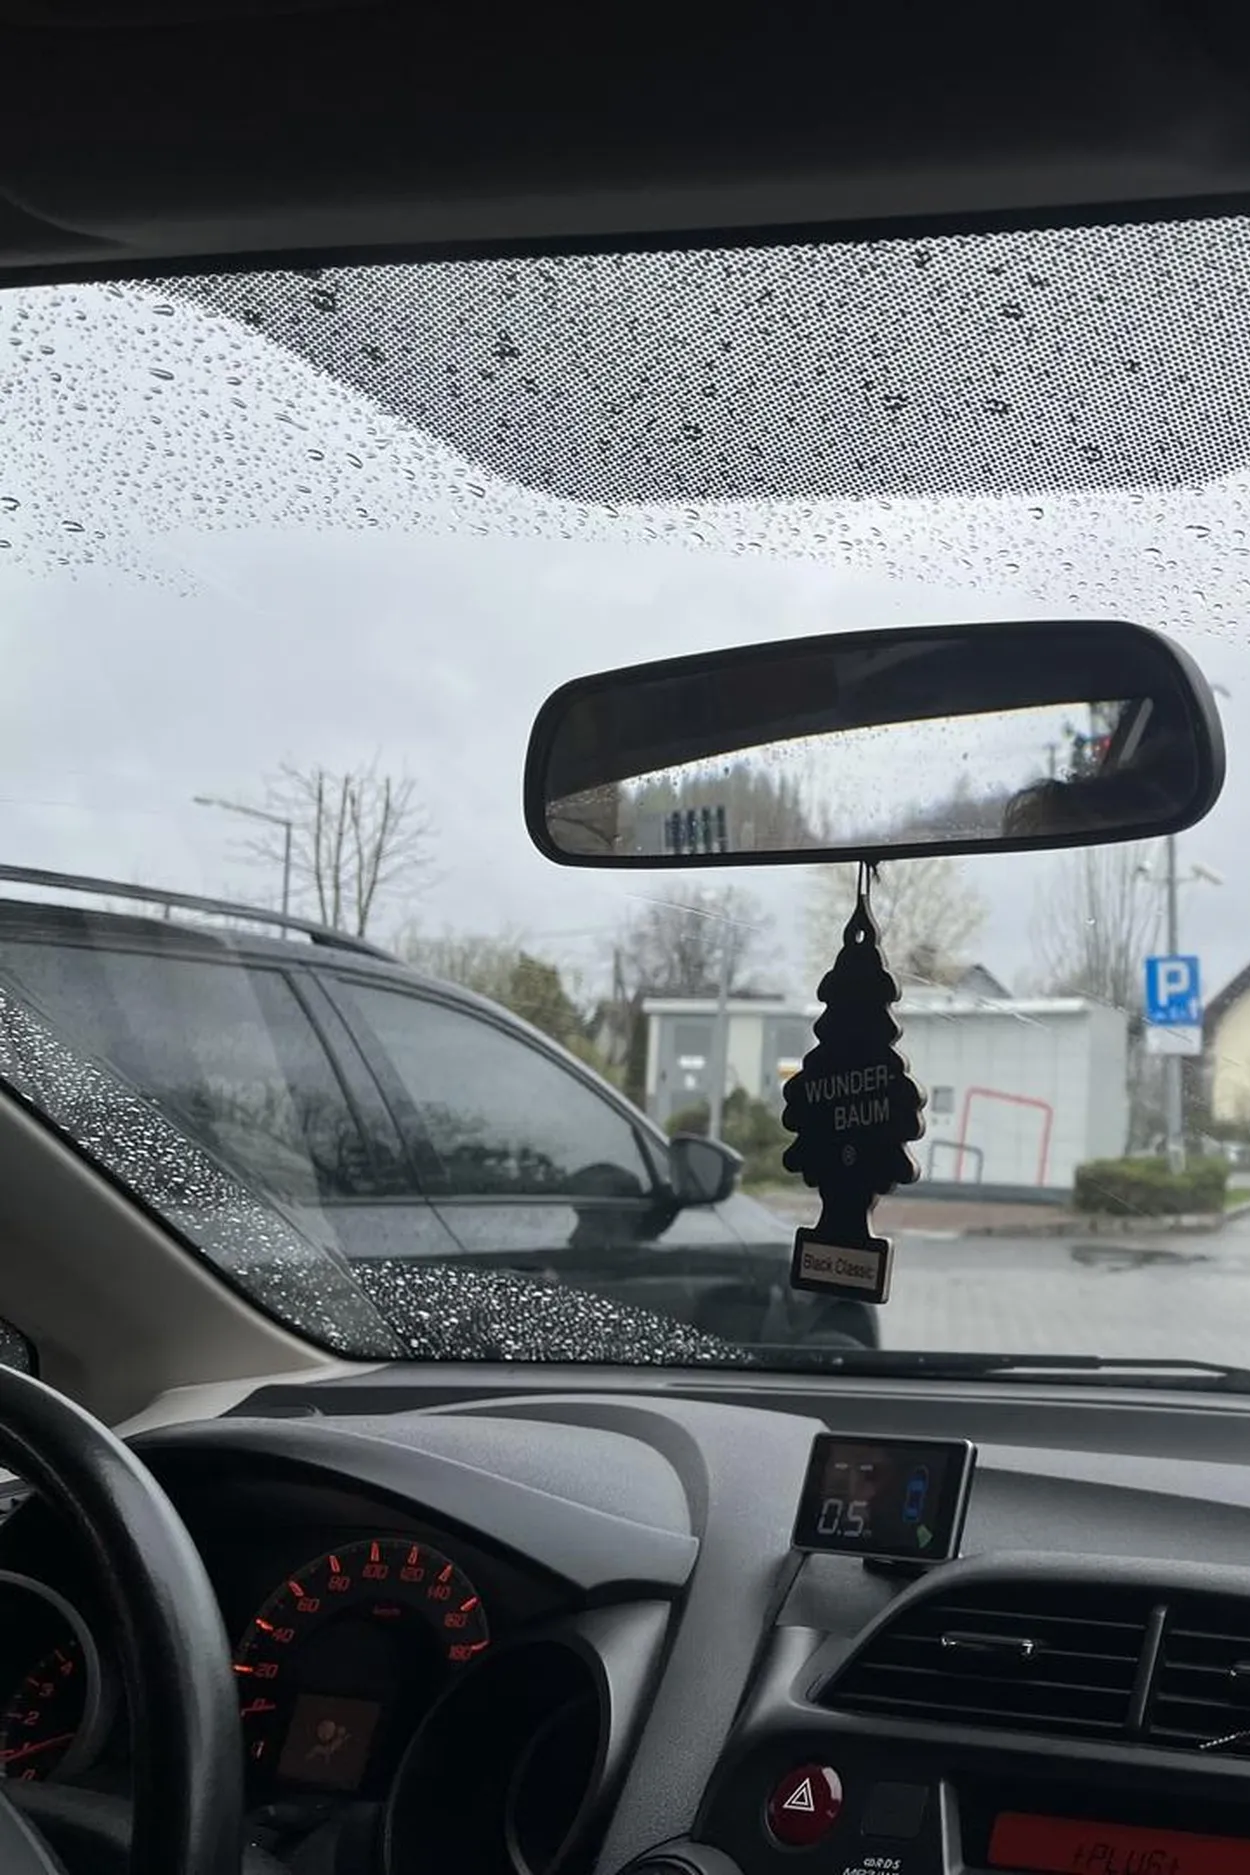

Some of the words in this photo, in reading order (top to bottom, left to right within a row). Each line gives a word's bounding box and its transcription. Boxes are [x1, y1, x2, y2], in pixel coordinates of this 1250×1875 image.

[1158, 961, 1190, 1007] P
[805, 1064, 896, 1102] WUNDER-
[834, 1098, 891, 1130] BAUM
[328, 1575, 351, 1592] 80
[296, 1597, 320, 1613] 60
[272, 1627, 295, 1643] 40
[255, 1664, 279, 1679] 20
[39, 1682, 54, 1697] 3
[24, 1710, 40, 1726] 2
